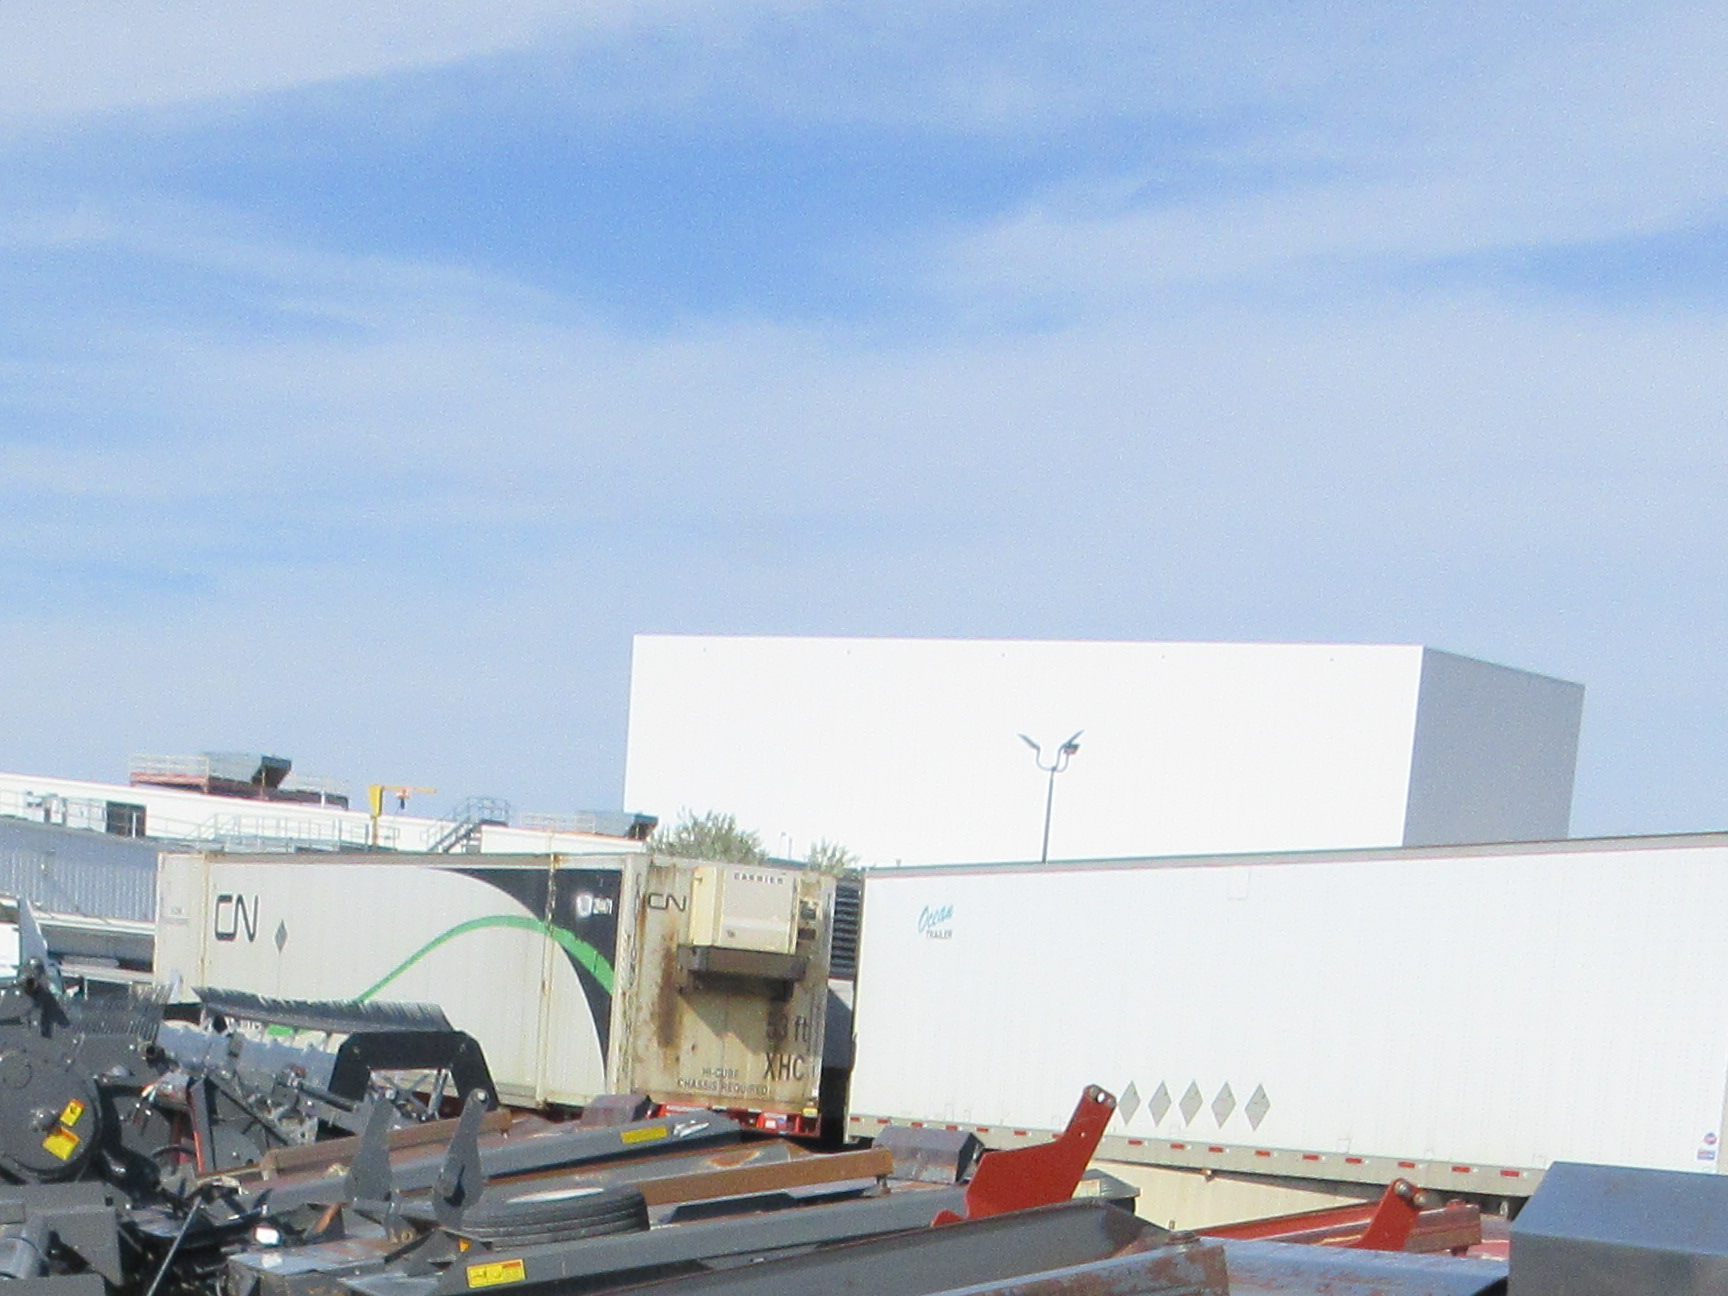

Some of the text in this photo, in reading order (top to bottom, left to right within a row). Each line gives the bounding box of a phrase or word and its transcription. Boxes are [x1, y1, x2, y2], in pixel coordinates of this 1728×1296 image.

[215, 893, 259, 943] CN
[648, 892, 687, 913] CN
[764, 1051, 805, 1082] XHC
